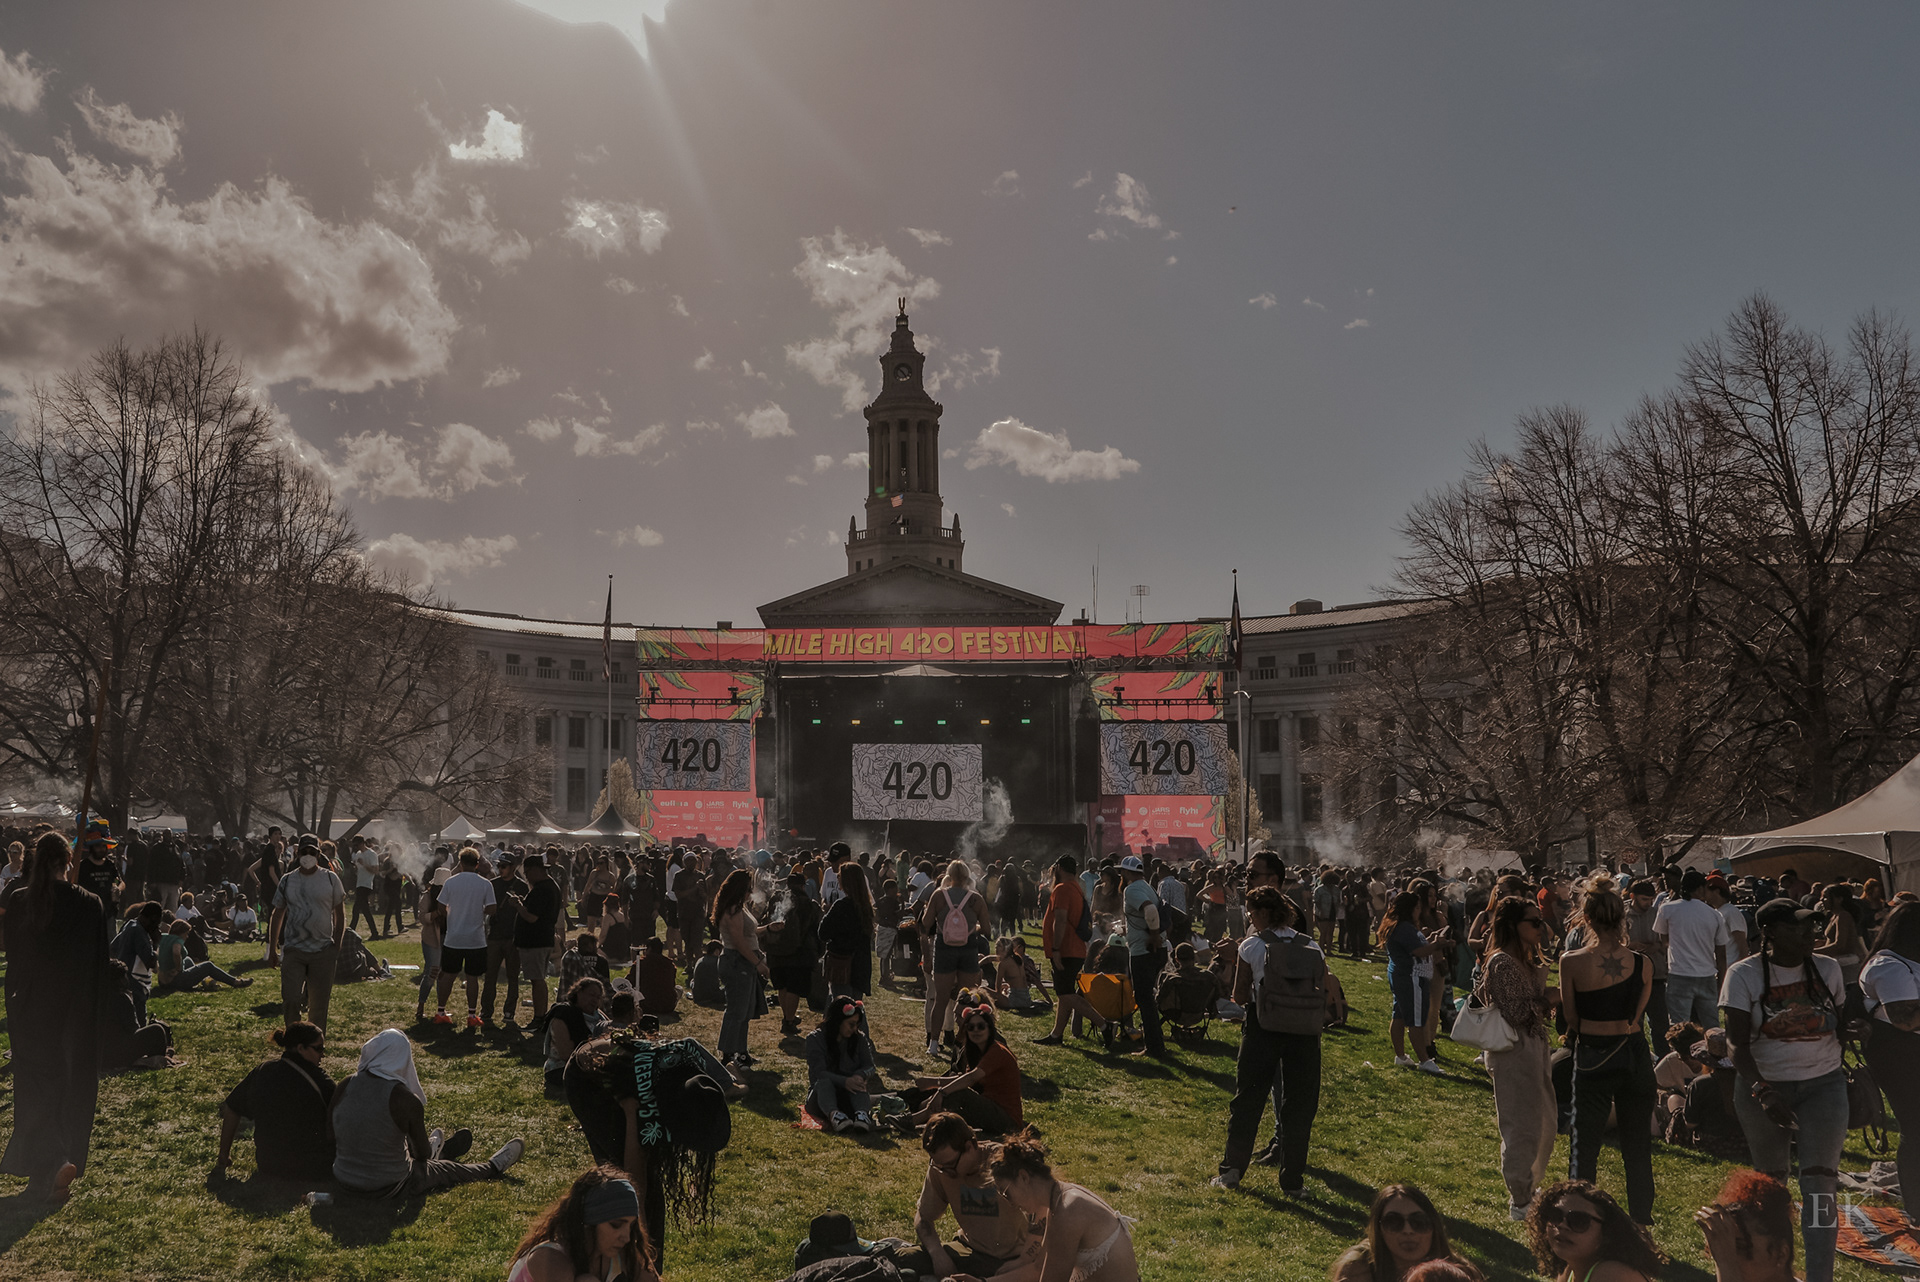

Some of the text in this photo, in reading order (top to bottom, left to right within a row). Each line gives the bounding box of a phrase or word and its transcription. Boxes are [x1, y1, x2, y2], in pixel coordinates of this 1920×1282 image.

[762, 631, 1087, 655] MILE HIGH 420 FESTIVAL
[661, 738, 721, 772] 420
[1129, 739, 1195, 775] 420
[882, 761, 952, 800] 420
